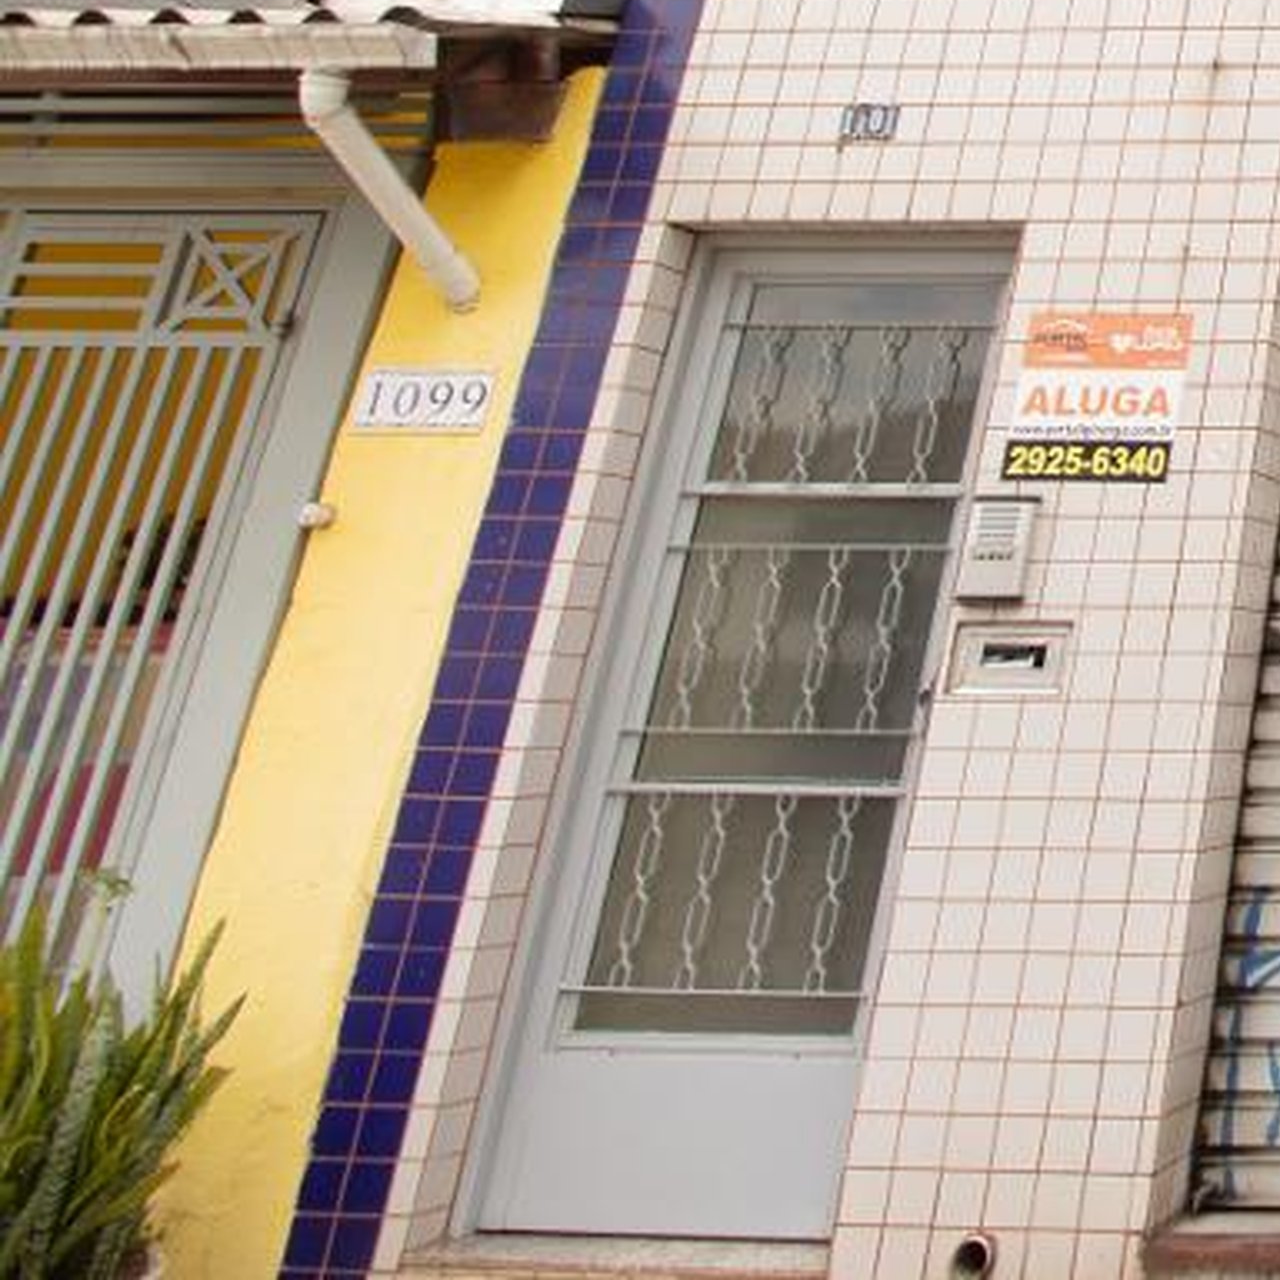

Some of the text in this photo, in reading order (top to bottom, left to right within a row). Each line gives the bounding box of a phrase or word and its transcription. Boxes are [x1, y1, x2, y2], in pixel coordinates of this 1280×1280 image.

[368, 380, 488, 417] 1099
[1022, 385, 1171, 417] ALUGA
[1006, 446, 1167, 477] 2925-6340
